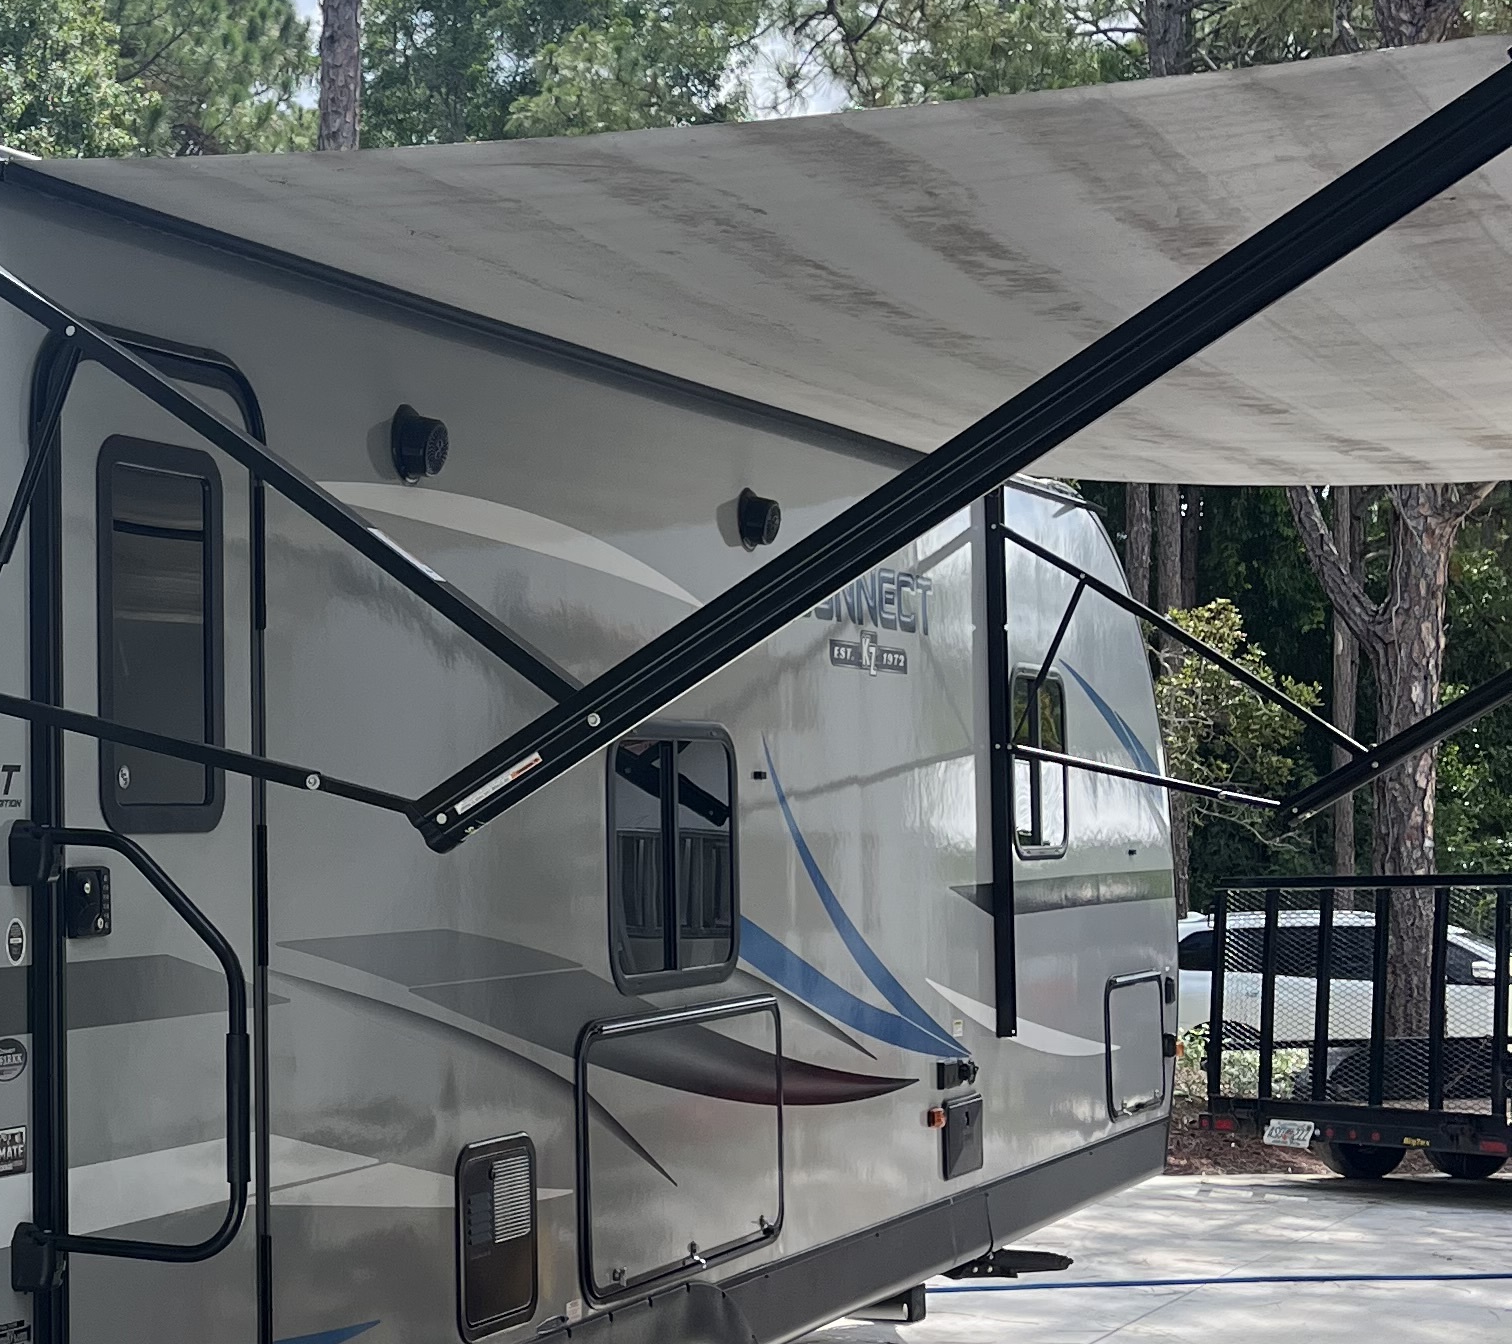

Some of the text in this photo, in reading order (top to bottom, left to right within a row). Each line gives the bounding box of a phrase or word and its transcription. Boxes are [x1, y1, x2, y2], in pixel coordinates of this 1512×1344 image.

[804, 567, 932, 636] NNECT
[834, 636, 905, 675] EST. KZ 1972
